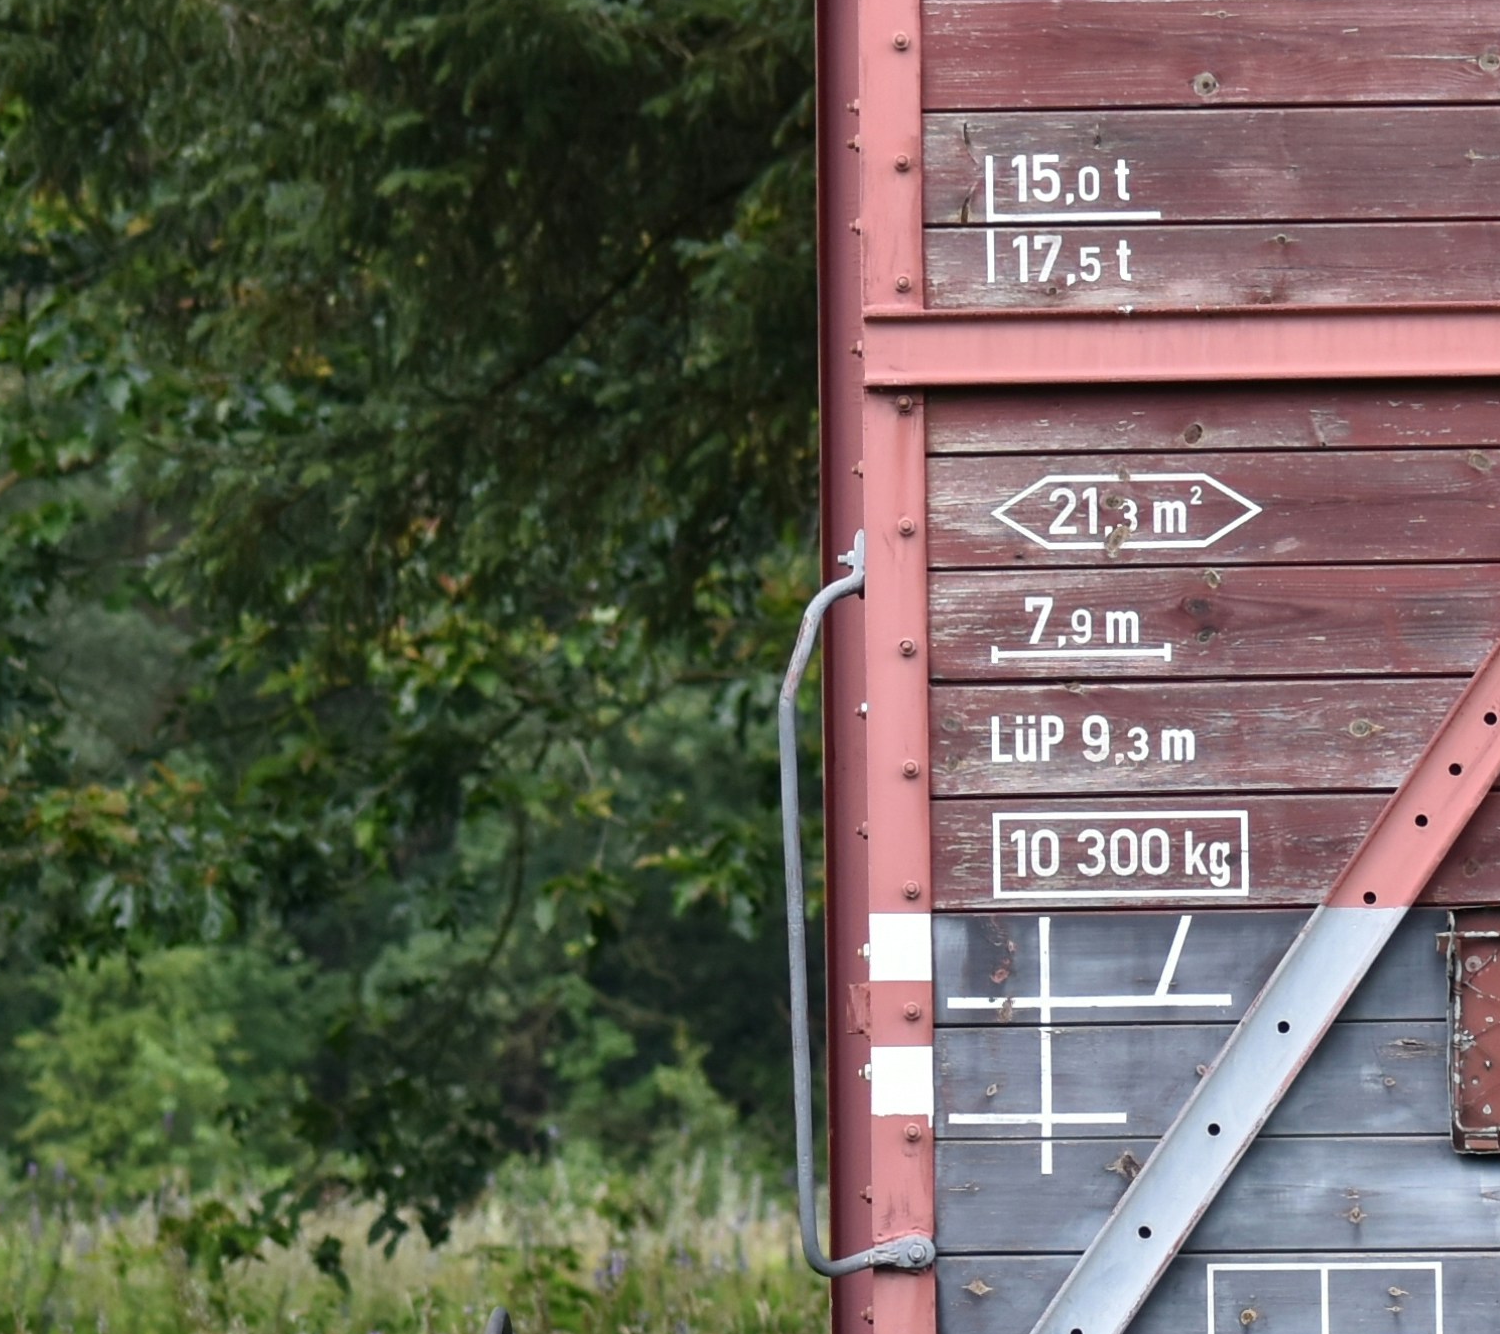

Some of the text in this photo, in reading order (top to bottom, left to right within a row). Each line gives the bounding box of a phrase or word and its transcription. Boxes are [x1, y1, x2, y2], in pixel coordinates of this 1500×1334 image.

[1012, 154, 1131, 205] 15,0 t
[1012, 235, 1132, 286] 17,5 t
[1049, 486, 1138, 535] 21,3
[1023, 597, 1140, 648] 7,9 m
[1081, 714, 1149, 766] 9,3
[1160, 727, 1196, 762] m
[1010, 827, 1231, 888] 10 300 kg
